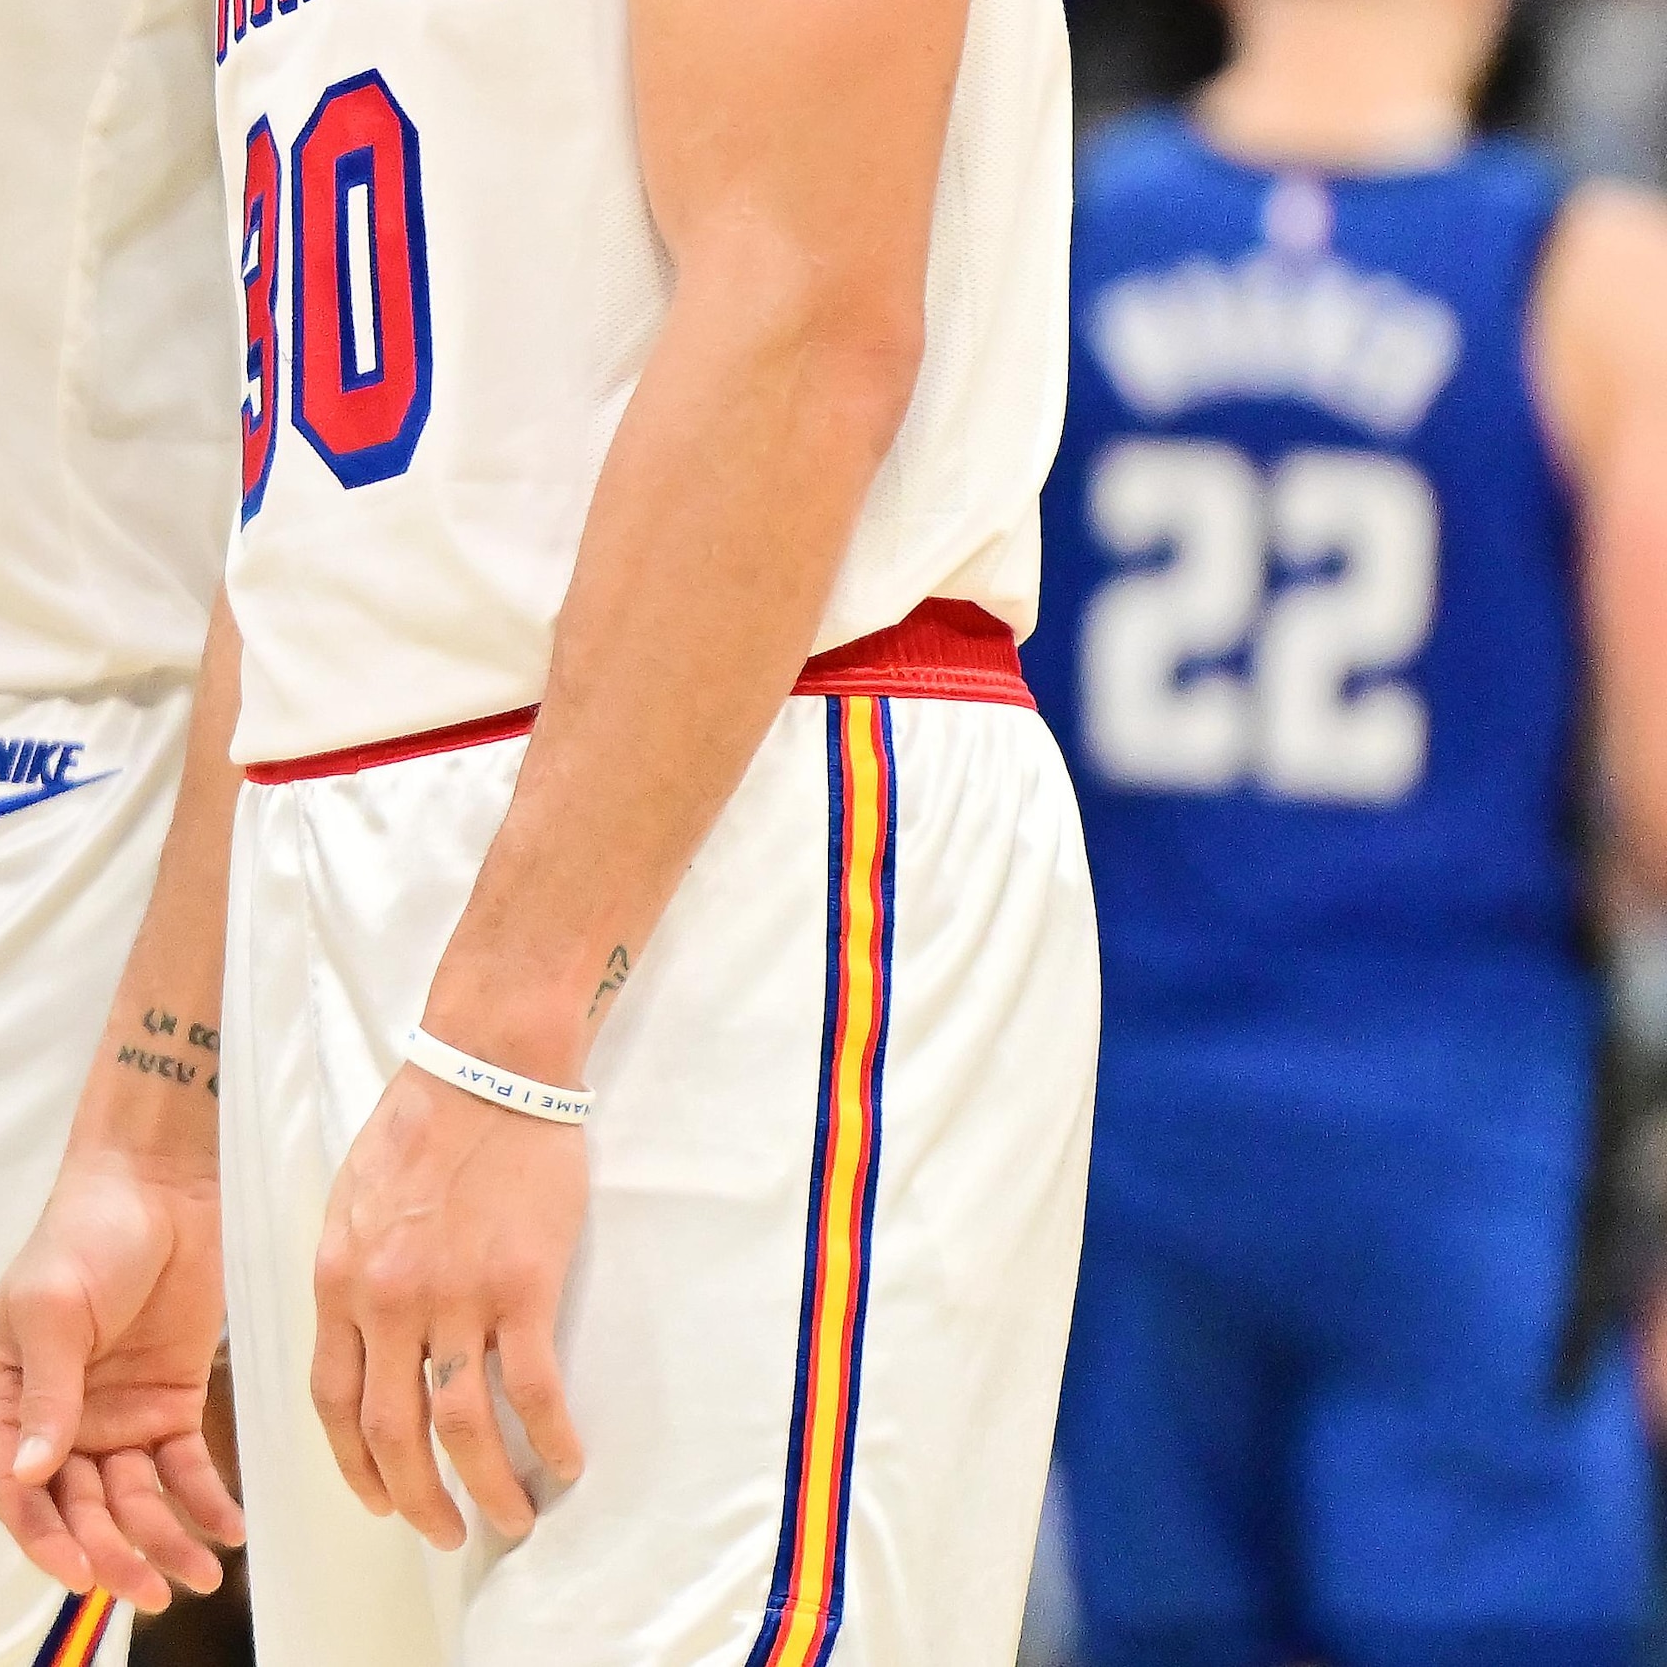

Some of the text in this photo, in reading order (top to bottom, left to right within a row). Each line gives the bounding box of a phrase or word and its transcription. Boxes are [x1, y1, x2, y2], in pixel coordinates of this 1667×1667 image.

[241, 69, 433, 532] 30
[1082, 438, 1440, 802] 22
[456, 1065, 514, 1098] PLAY
